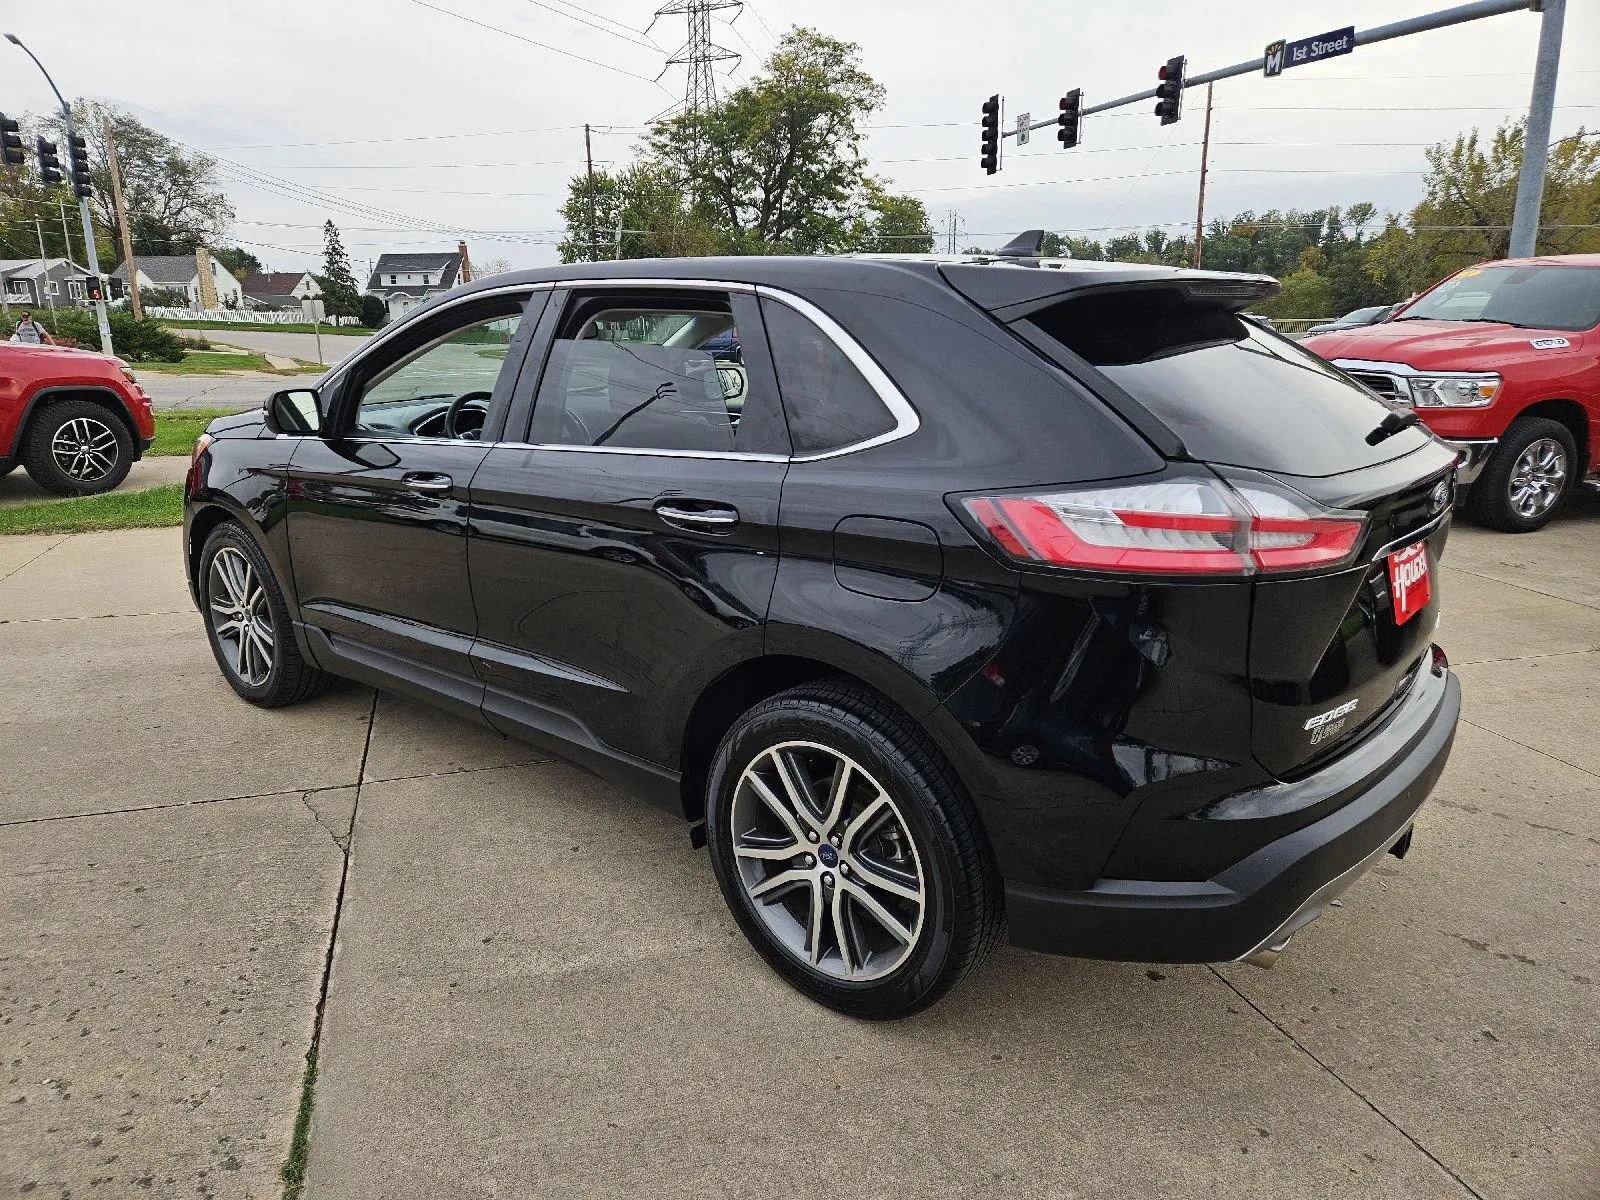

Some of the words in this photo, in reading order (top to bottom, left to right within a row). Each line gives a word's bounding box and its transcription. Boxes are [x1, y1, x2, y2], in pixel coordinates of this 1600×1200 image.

[1292, 45, 1308, 62] 1st
[1310, 35, 1348, 57] Street
[1266, 51, 1282, 74] M
[93, 289, 100, 299] 5
